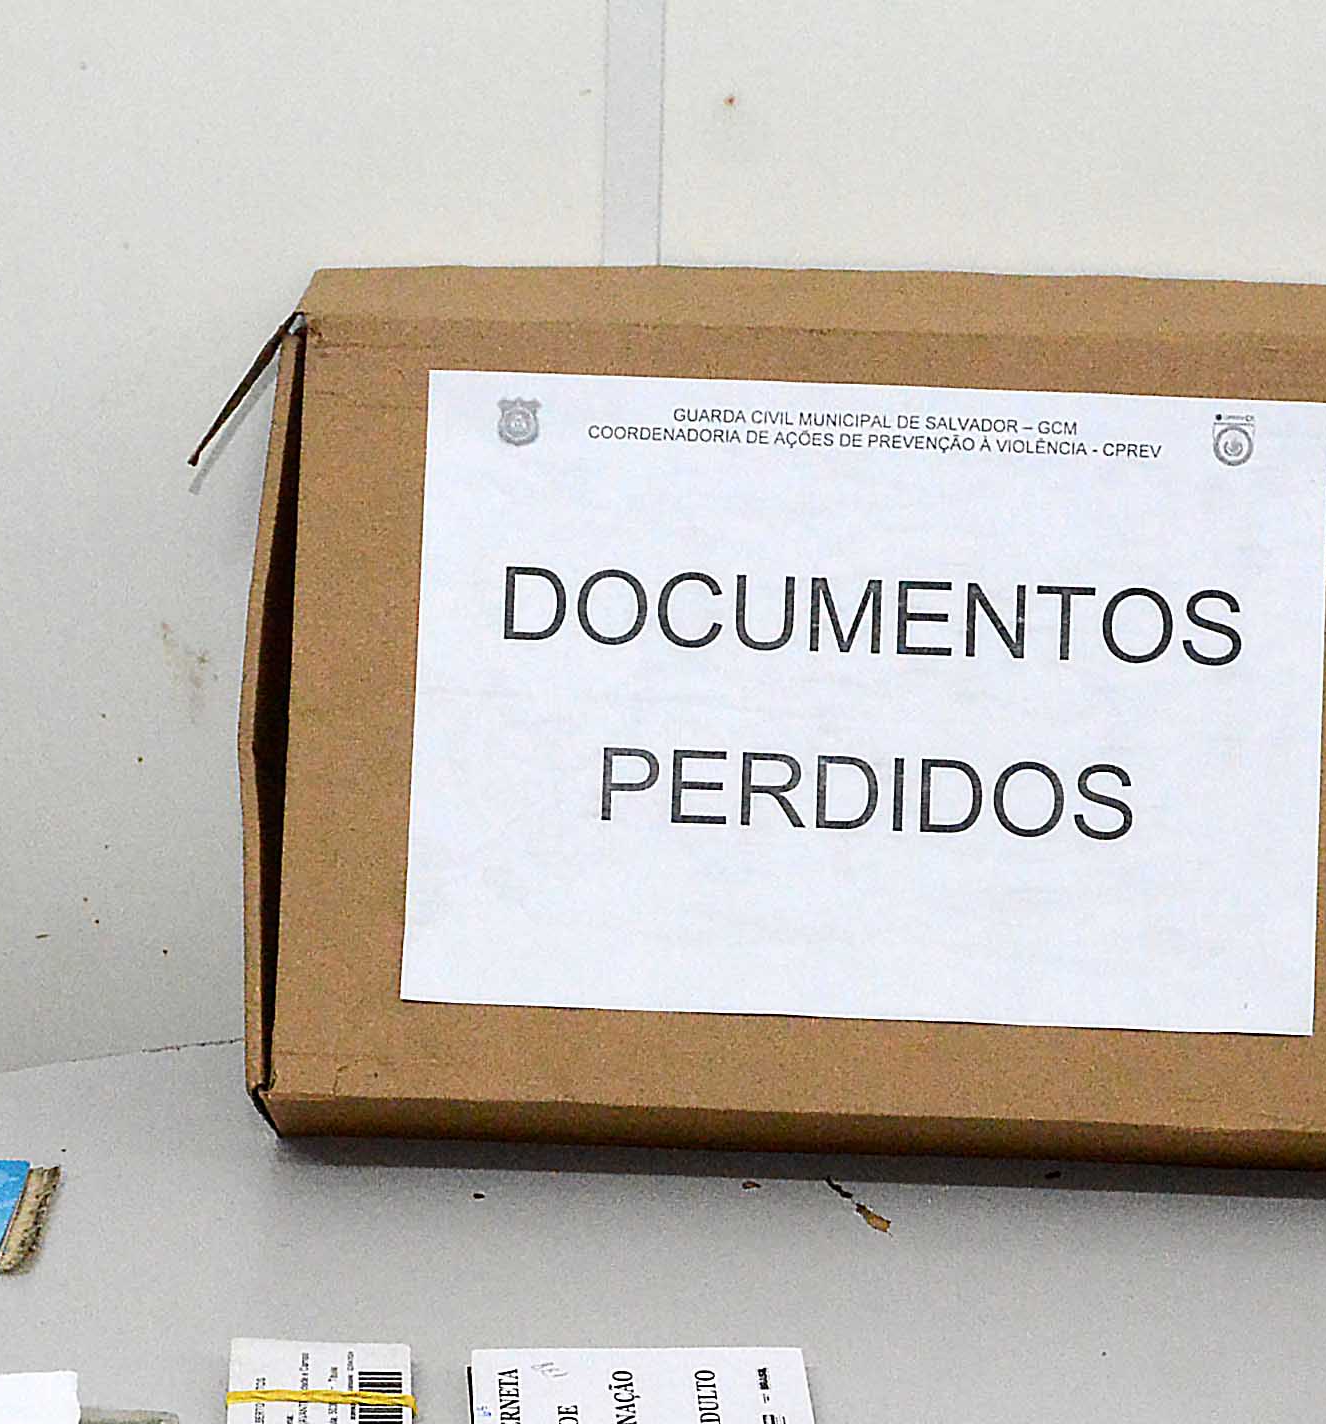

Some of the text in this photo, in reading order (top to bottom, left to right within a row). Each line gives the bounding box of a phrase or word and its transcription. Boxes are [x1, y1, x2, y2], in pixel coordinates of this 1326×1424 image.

[588, 425, 740, 444] COORDENADORIA
[746, 430, 769, 444] DE
[774, 429, 834, 449] AÇÕES
[839, 433, 862, 448] DE
[868, 434, 974, 453] PREVENÇÃO
[997, 437, 1090, 456] VIOLÊNCIA
[1103, 443, 1162, 459] CPREV
[673, 408, 745, 424] GUARDA
[751, 410, 794, 426] CIVIL
[798, 412, 891, 429] MUNICIPAL
[897, 415, 920, 430] DE
[925, 416, 1018, 433] SALVADOR
[1037, 420, 1077, 435] GCM
[502, 566, 1243, 667] DOCUMENTOS
[600, 747, 1135, 841] PERDIDOS
